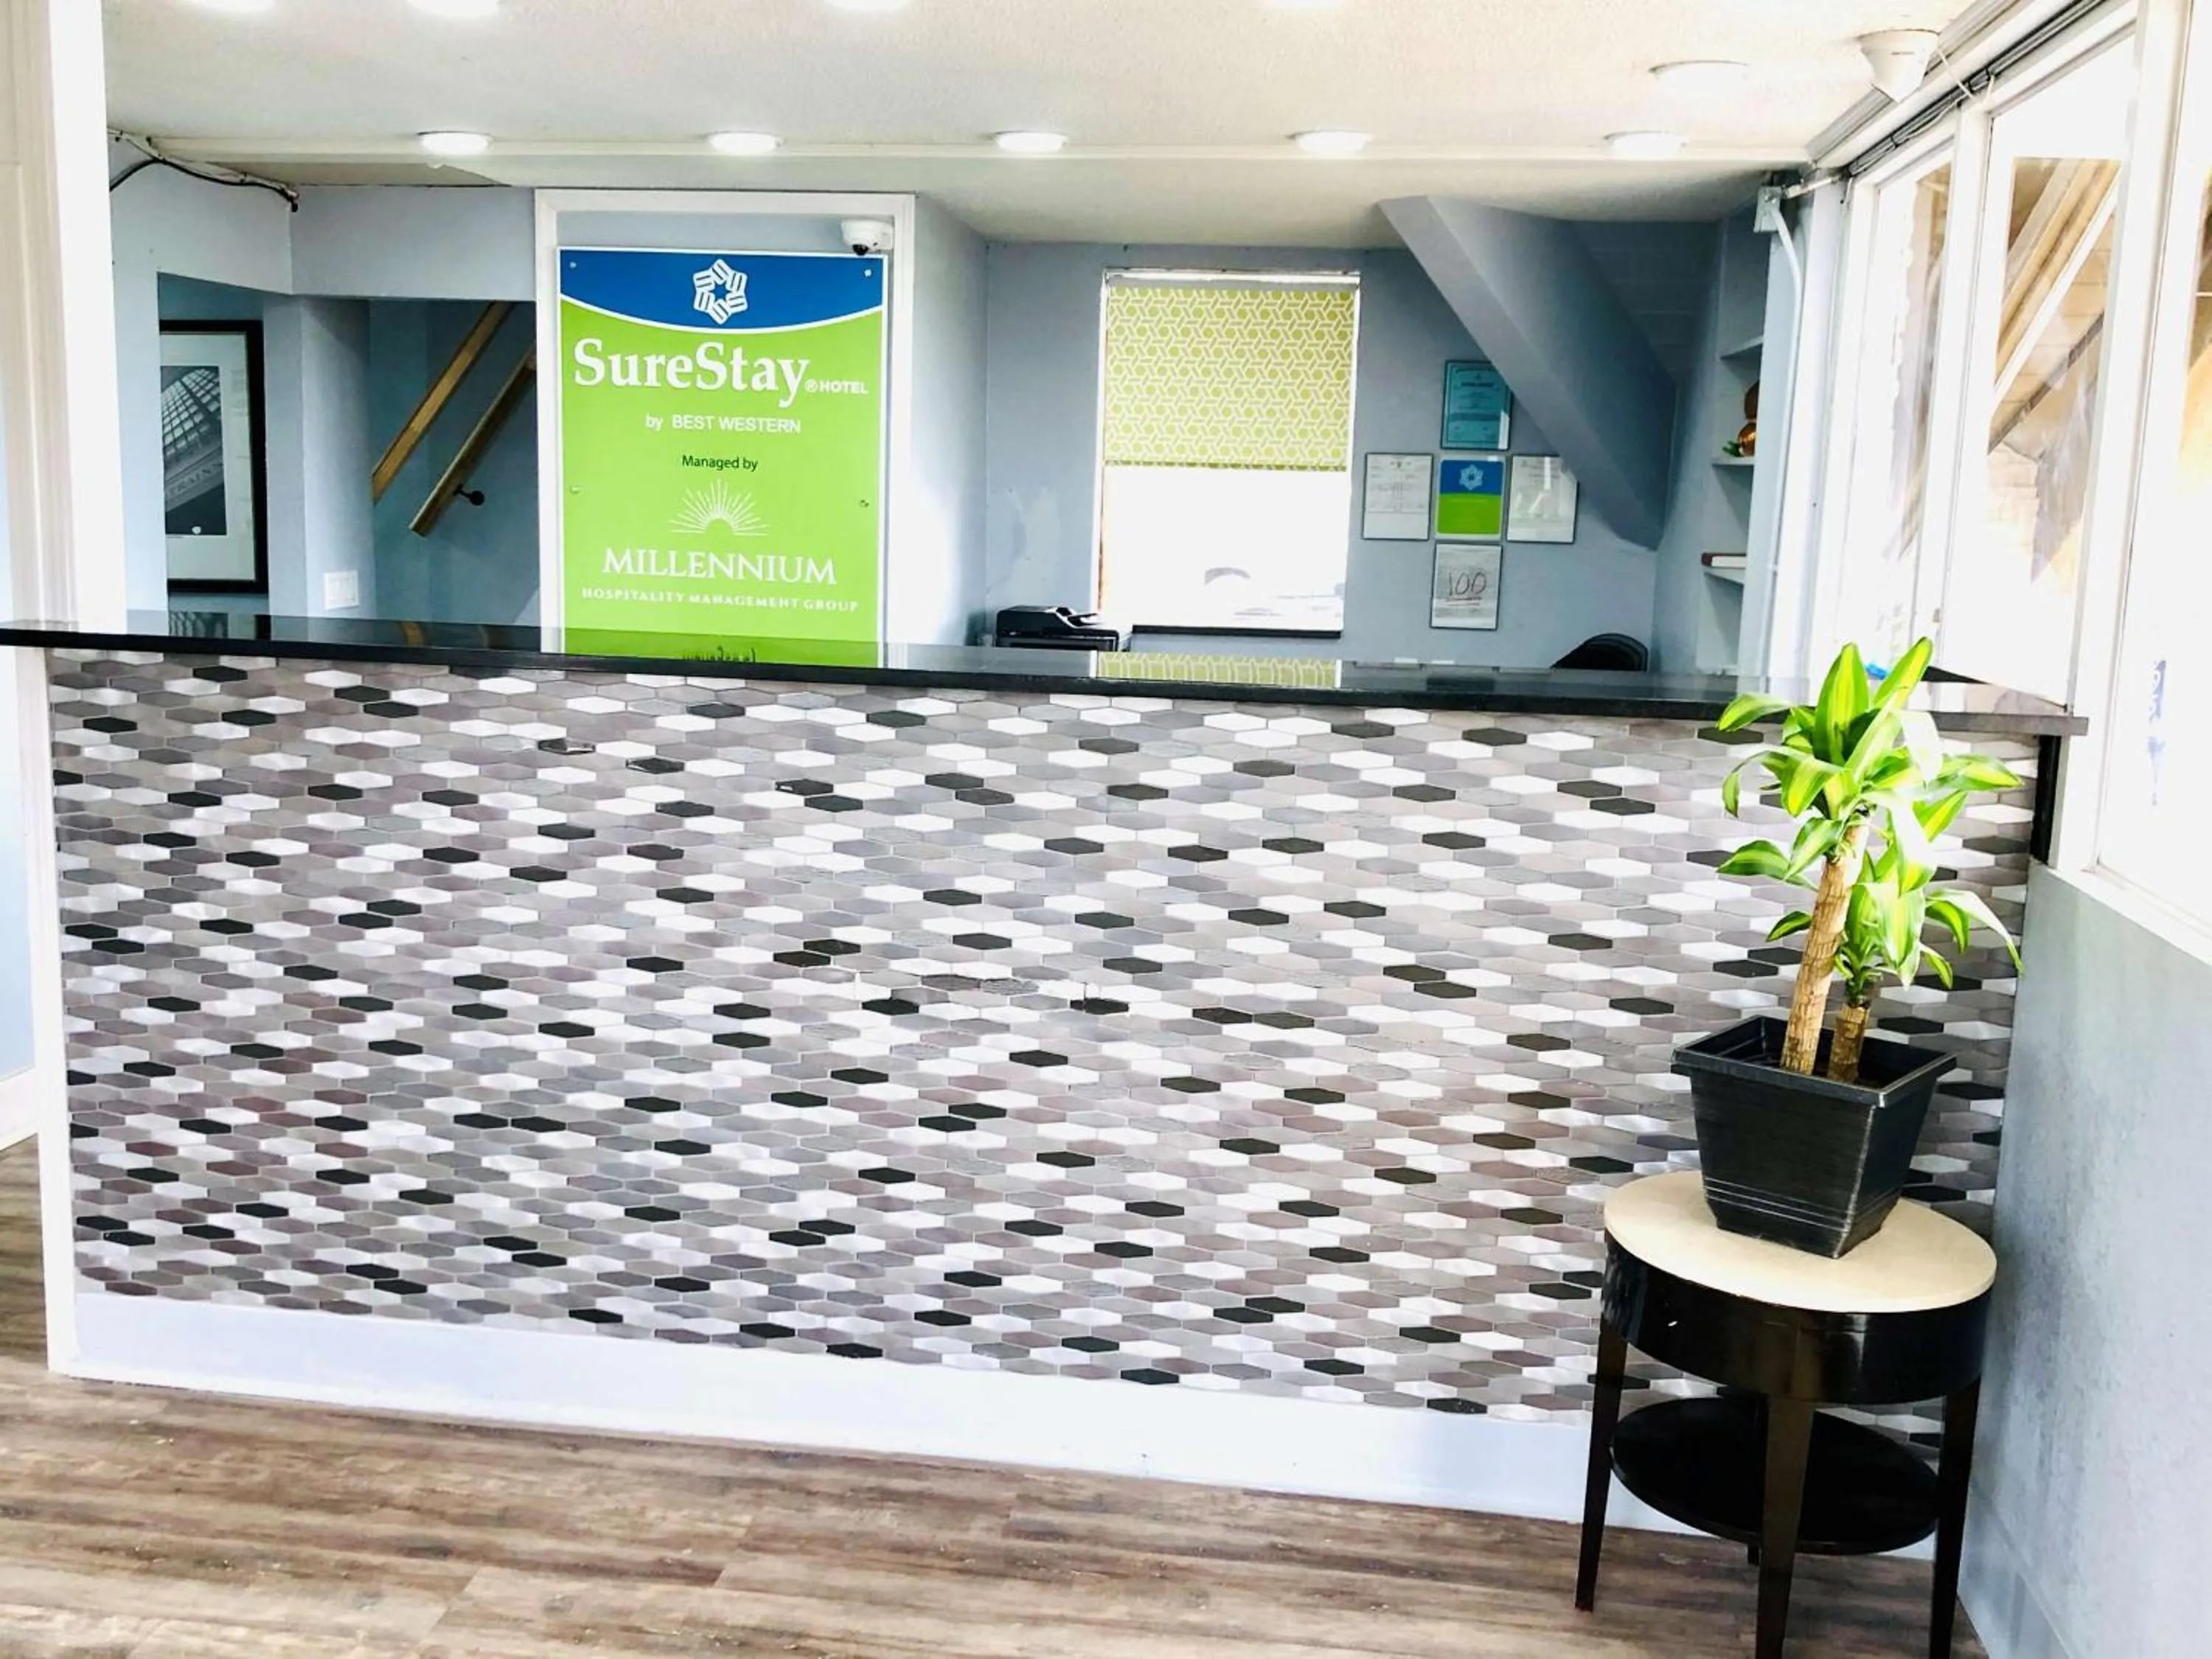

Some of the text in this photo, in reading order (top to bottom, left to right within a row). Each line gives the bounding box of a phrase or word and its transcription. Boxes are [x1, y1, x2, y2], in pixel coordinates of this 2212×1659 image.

[820, 380, 869, 394] HOTEL
[645, 414, 801, 434] by BEST WESTERN
[681, 454, 759, 473] Managed by
[602, 547, 838, 585] MILLENNIUM
[1447, 571, 1487, 597] 100
[582, 587, 860, 612] HOSPITALITY MANAGEMENT GROUP
